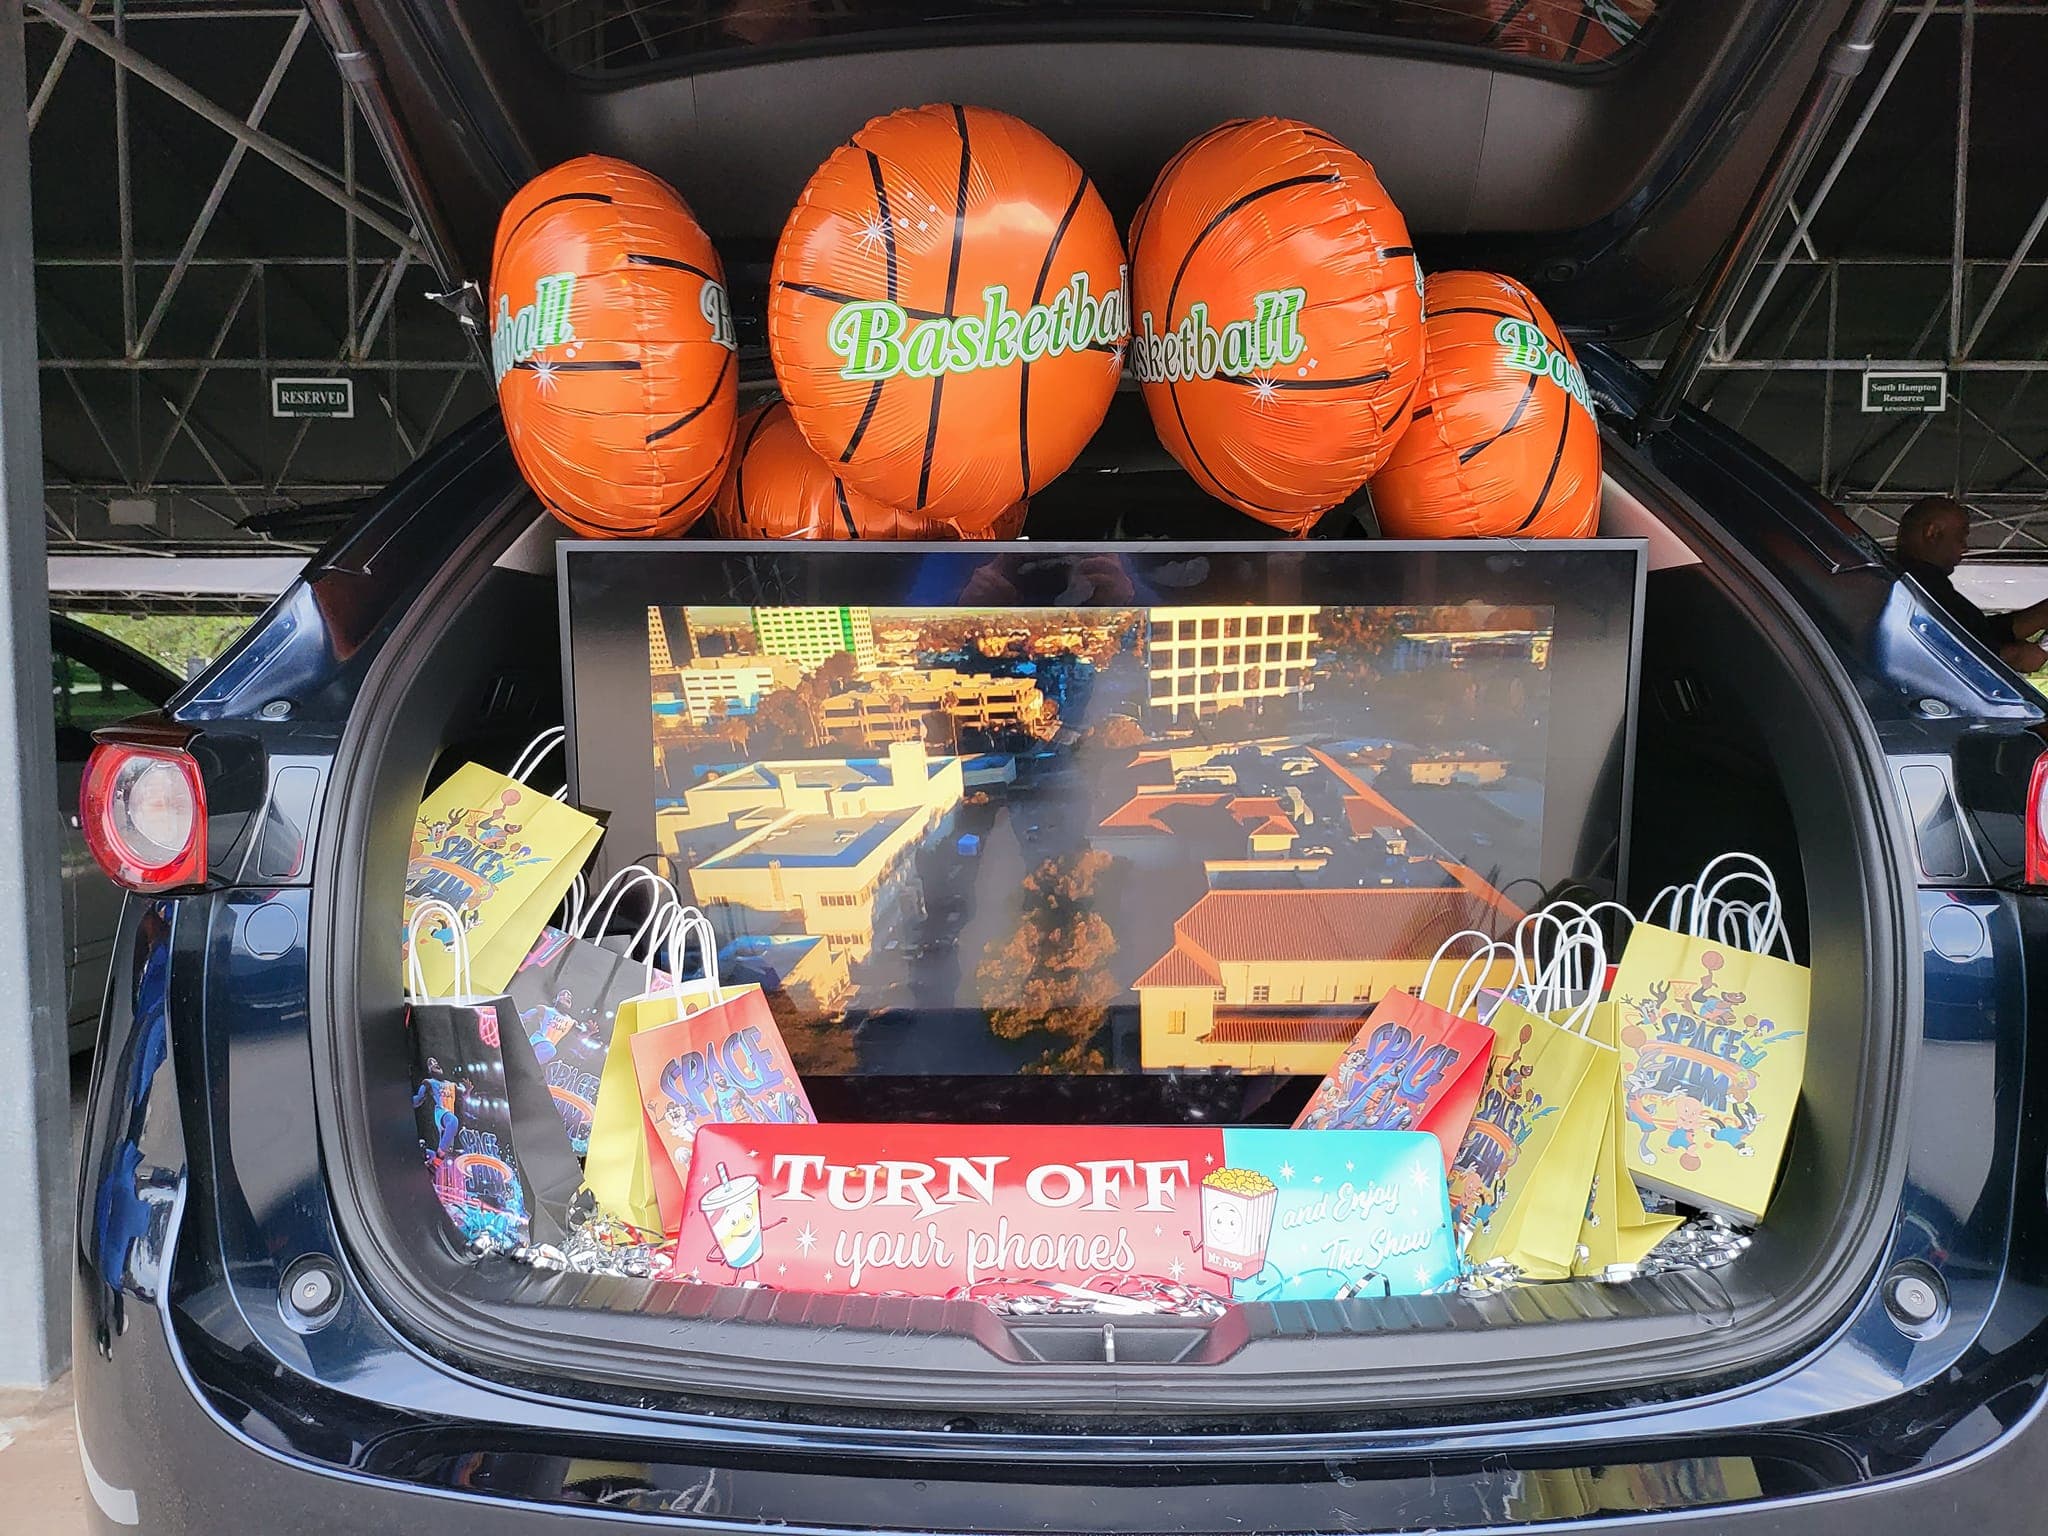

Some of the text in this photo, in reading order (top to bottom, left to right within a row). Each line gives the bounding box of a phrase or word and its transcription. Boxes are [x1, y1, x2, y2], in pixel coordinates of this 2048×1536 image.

[826, 264, 1131, 381] Basketbal
[281, 391, 345, 404] RESERVED
[1871, 383, 1937, 393] South Hampton
[1883, 394, 1925, 402] Resources
[431, 835, 504, 880] SPACE
[1349, 1021, 1461, 1103] SPACE
[1657, 1012, 1744, 1064] SPACE
[659, 1025, 784, 1122] SPACE
[1478, 1088, 1524, 1134] SPACE
[459, 1127, 501, 1160] SPACE
[772, 1155, 1191, 1220] TURN OFF
[1282, 1181, 1400, 1230] and Enjoy
[834, 1216, 1136, 1288] your phones
[1321, 1225, 1434, 1278] The Show
